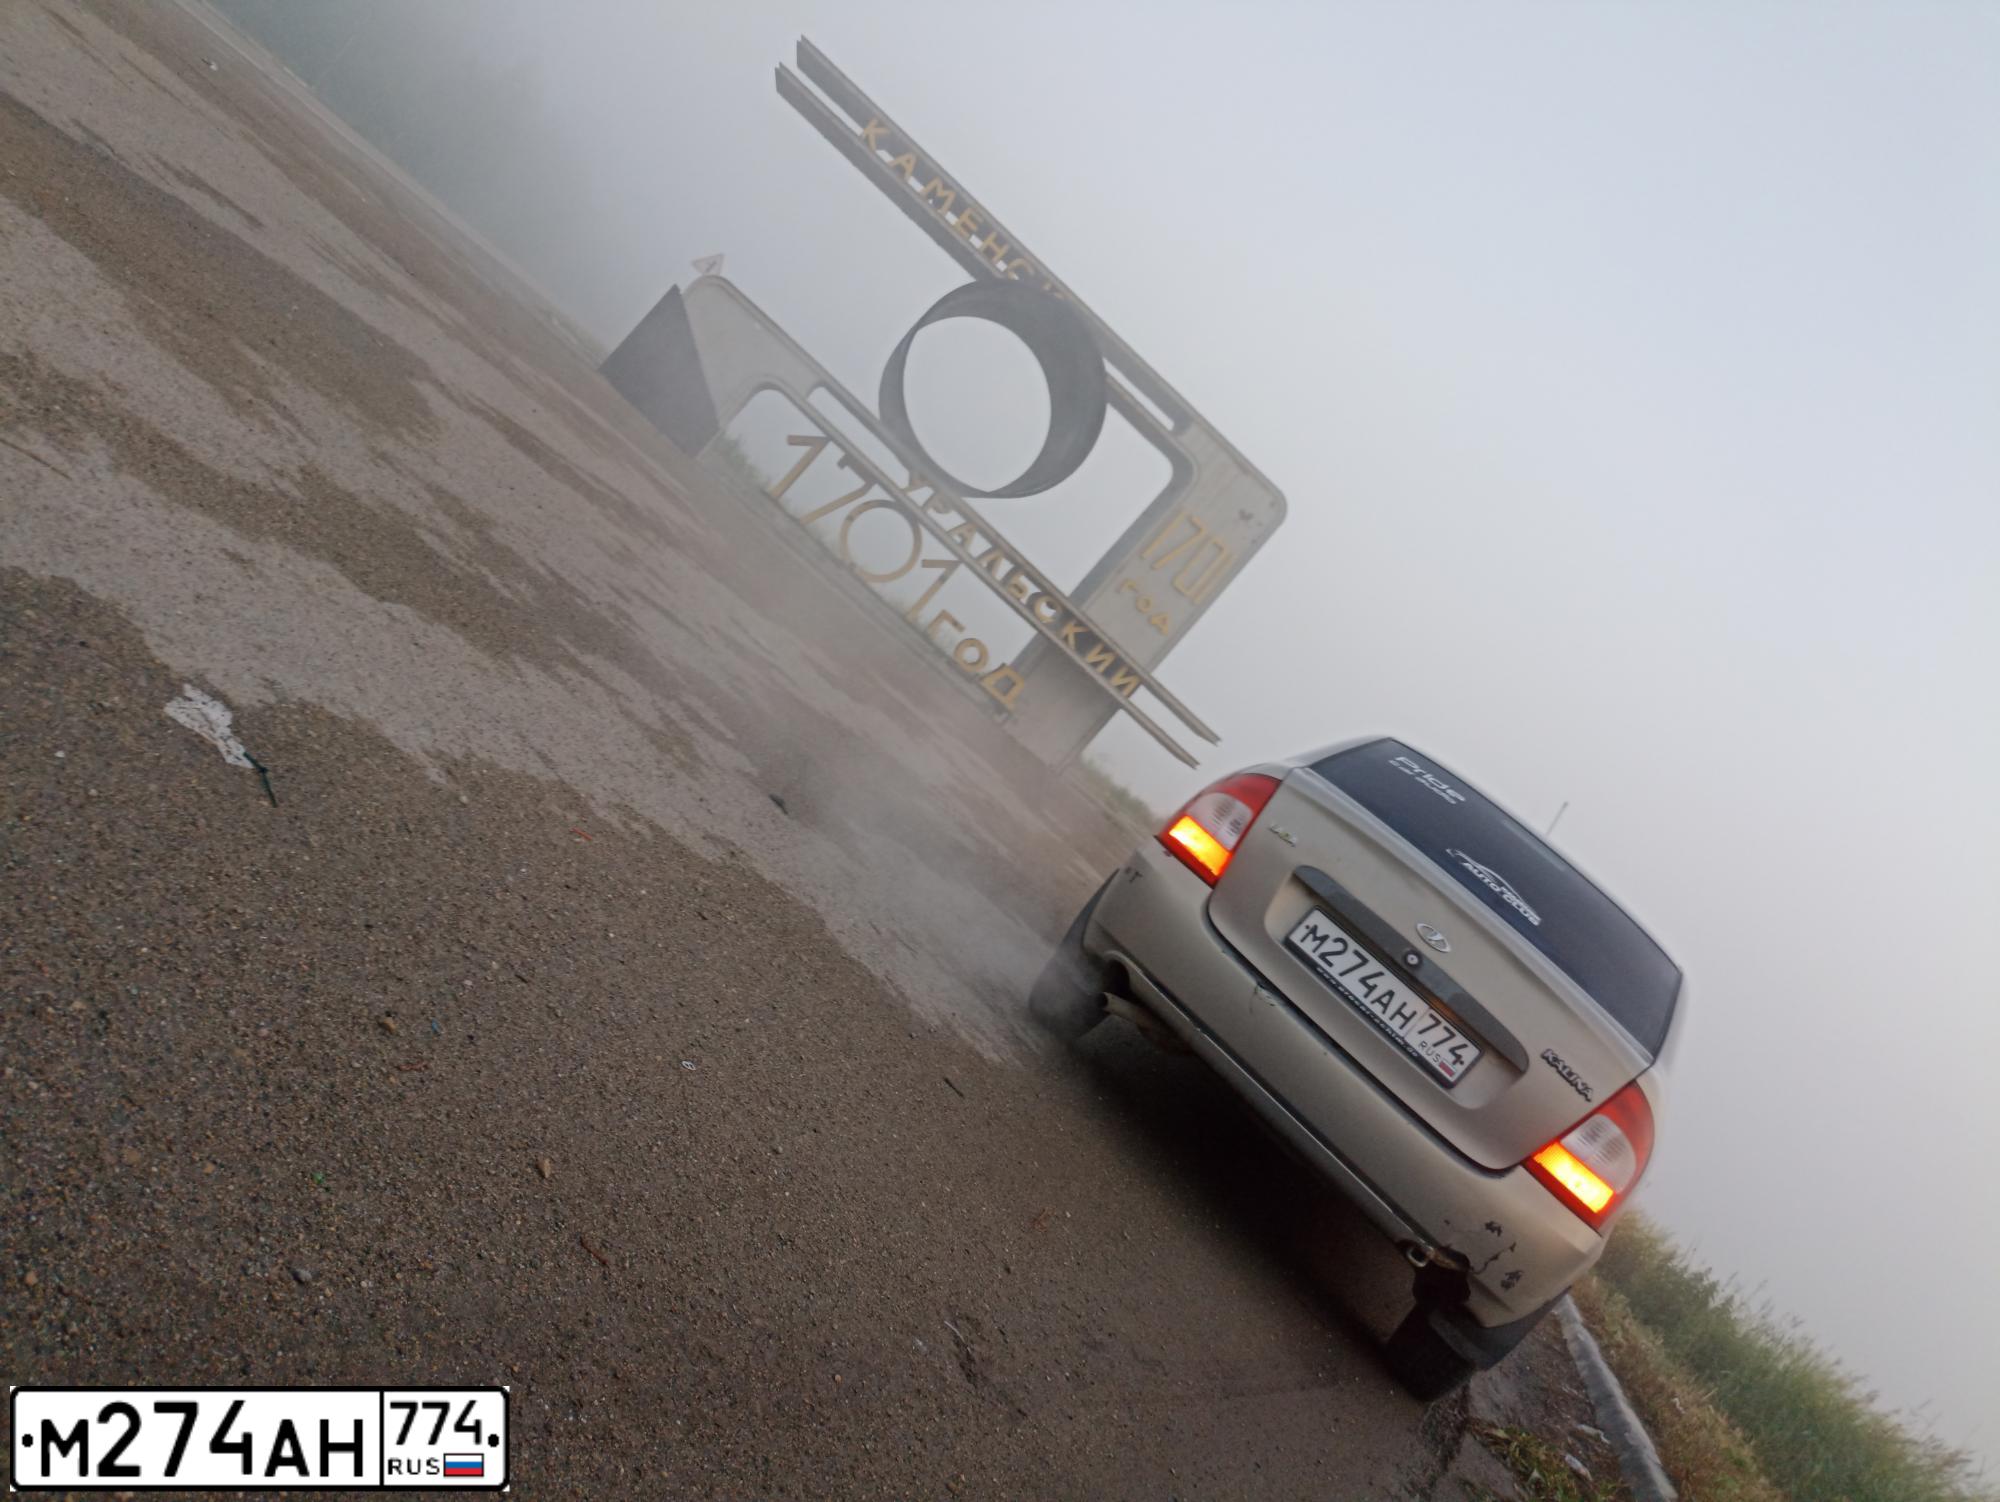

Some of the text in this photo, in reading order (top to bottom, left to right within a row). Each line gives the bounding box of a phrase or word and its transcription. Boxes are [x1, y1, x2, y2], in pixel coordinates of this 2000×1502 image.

[769, 434, 962, 624] 1701
[1138, 511, 1238, 605] 1701
[1394, 756, 1466, 801] Pride
[1418, 1013, 1468, 1065] 774
[1418, 1041, 1441, 1063] RUS
[1540, 1048, 1594, 1103] KALINA
